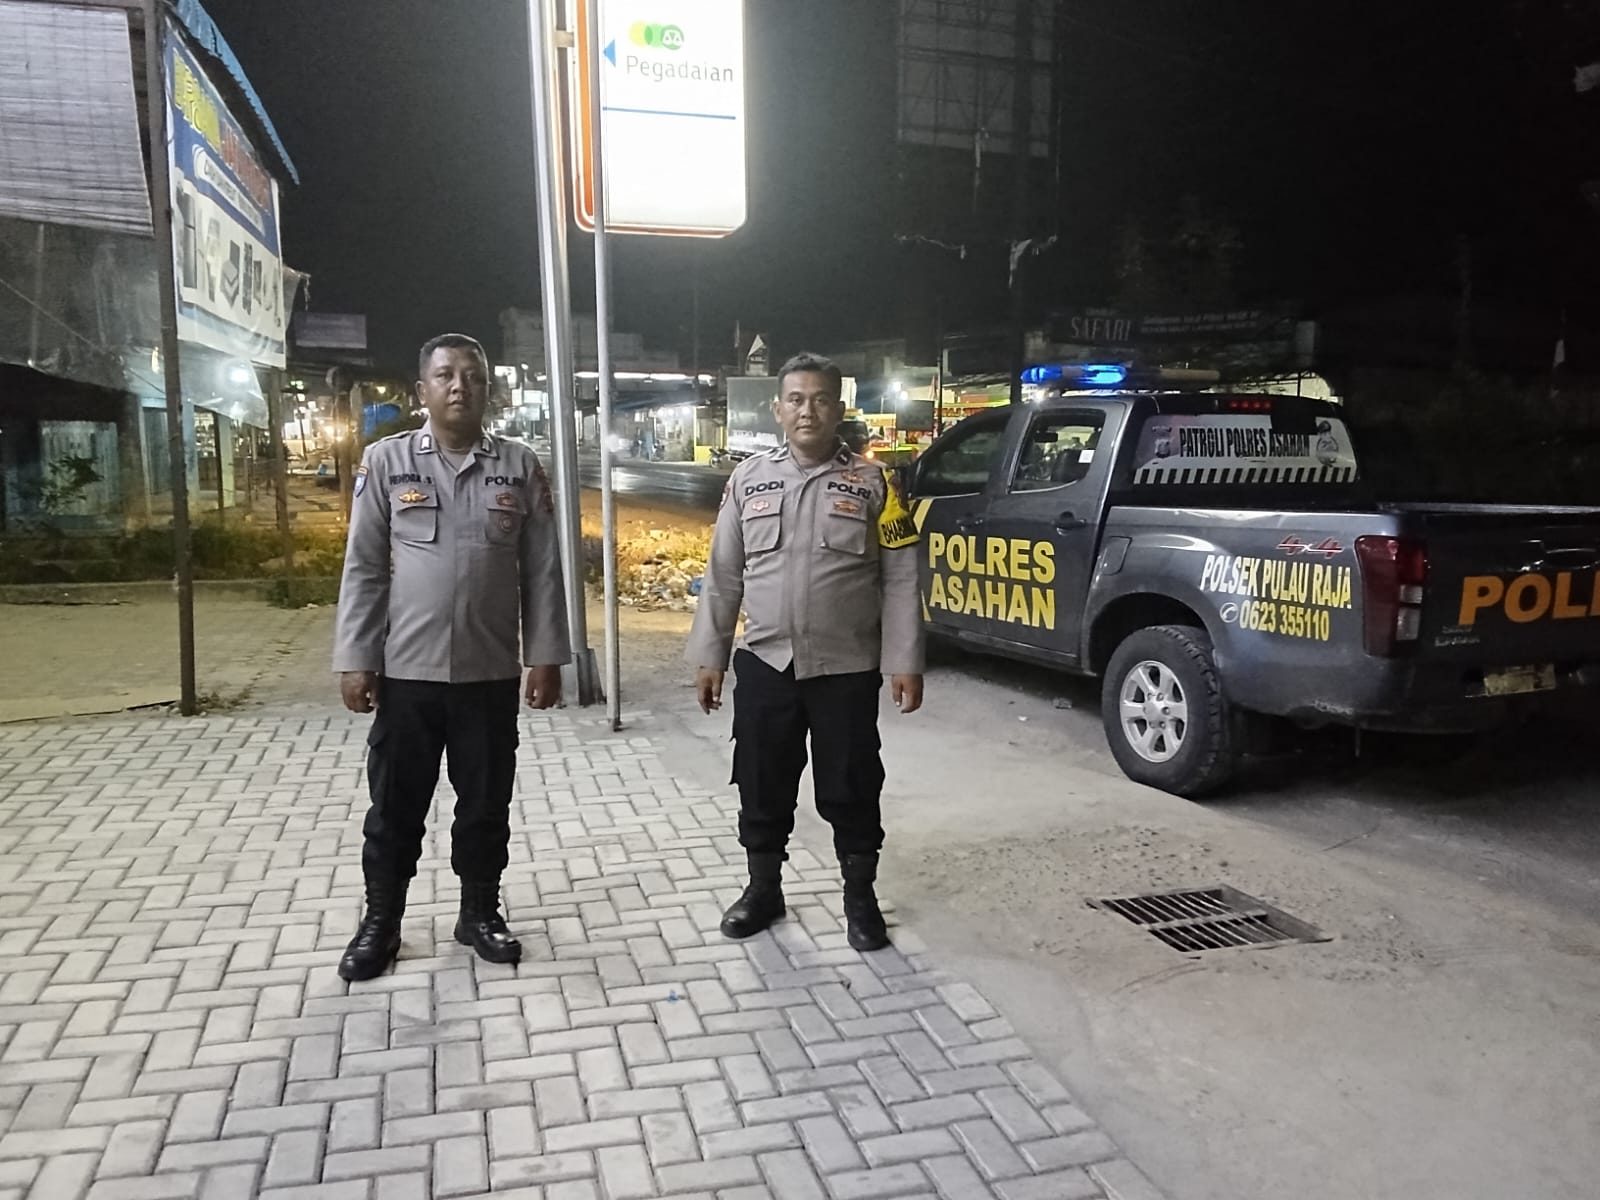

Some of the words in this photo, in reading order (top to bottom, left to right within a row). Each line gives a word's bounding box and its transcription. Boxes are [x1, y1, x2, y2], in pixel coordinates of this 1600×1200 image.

[625, 54, 734, 82] Pegadaian
[1070, 315, 1132, 342] SAFARI
[1179, 427, 1224, 458] PATROLI
[1226, 427, 1266, 458] POLRES
[484, 475, 526, 489] POLRI
[744, 480, 785, 497] DODI
[827, 481, 873, 499] POLRI
[929, 532, 1056, 584] POLRES
[1275, 533, 1345, 559] 4x4
[1199, 554, 1261, 597] POLSEK
[1261, 559, 1310, 603] PULAU
[929, 573, 1055, 630] ASAHAN
[1239, 599, 1276, 633] 0623
[1279, 604, 1330, 642] 355110
